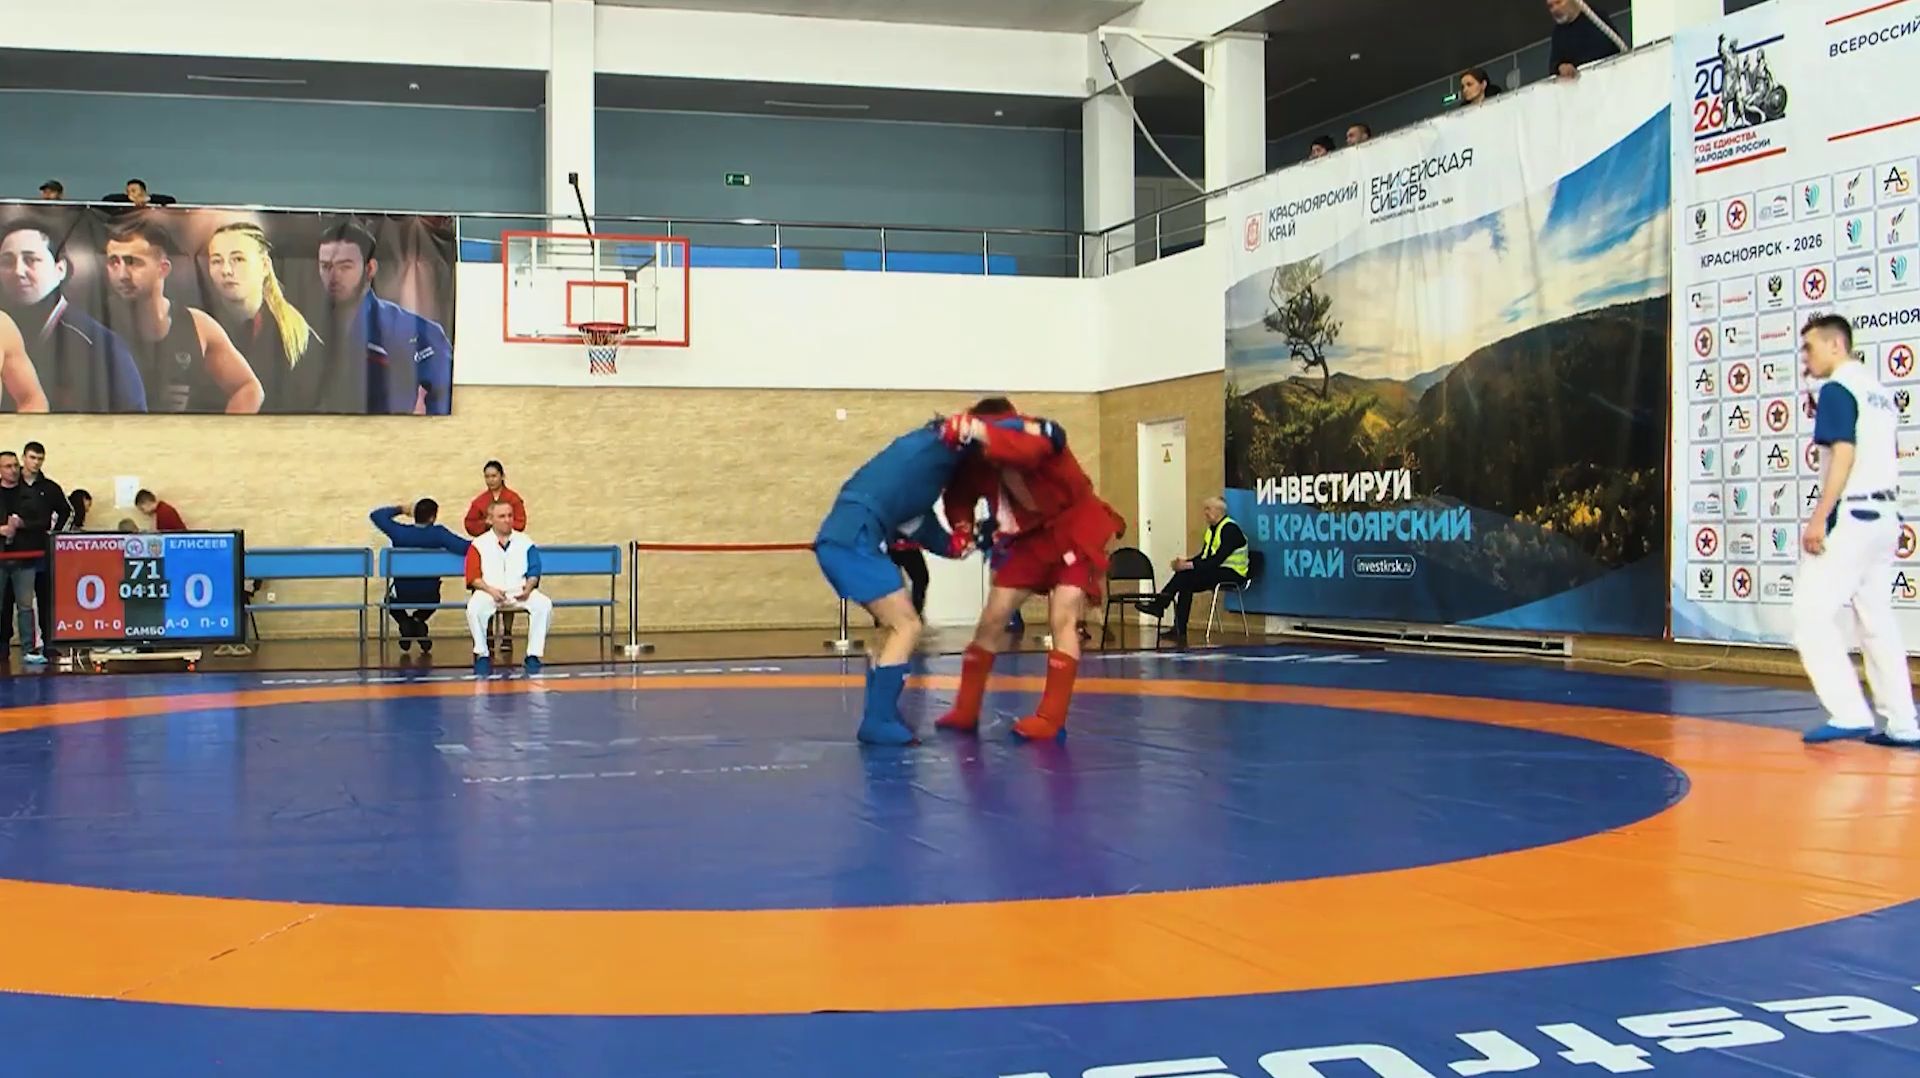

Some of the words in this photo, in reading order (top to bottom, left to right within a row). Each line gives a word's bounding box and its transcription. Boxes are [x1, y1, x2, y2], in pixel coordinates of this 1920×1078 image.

[1694, 64, 1724, 100] 20
[1694, 96, 1723, 132] 26
[1694, 142, 1711, 153] ГОД
[1713, 131, 1757, 150] ЕДИНСТВА
[1695, 147, 1733, 164] НАРОДОВ
[1736, 138, 1771, 153] РОССИИ
[1370, 148, 1473, 196] ЕНИСЕЙСКАЯ
[1268, 181, 1358, 224] КРАСНОЯРСКИЙ
[1370, 183, 1427, 215] СИБИРЬ
[1268, 219, 1296, 243] КРАЙ
[1701, 241, 1782, 268] КРАСНОЯРСК
[1794, 234, 1823, 252] 2026
[1257, 467, 1411, 505] ИНВЕСТИРУЙ
[1258, 514, 1270, 542] В
[1274, 506, 1472, 542] КРАСНОЯРСКИЙ
[170, 539, 228, 549] ЕЛИСЕЕВ
[129, 560, 160, 579] 71
[1284, 547, 1345, 578] КРАЙ
[1357, 559, 1412, 573] investkrsk.ru
[77, 574, 105, 610] 0
[185, 573, 213, 608] 0
[125, 626, 165, 636] САМБО
